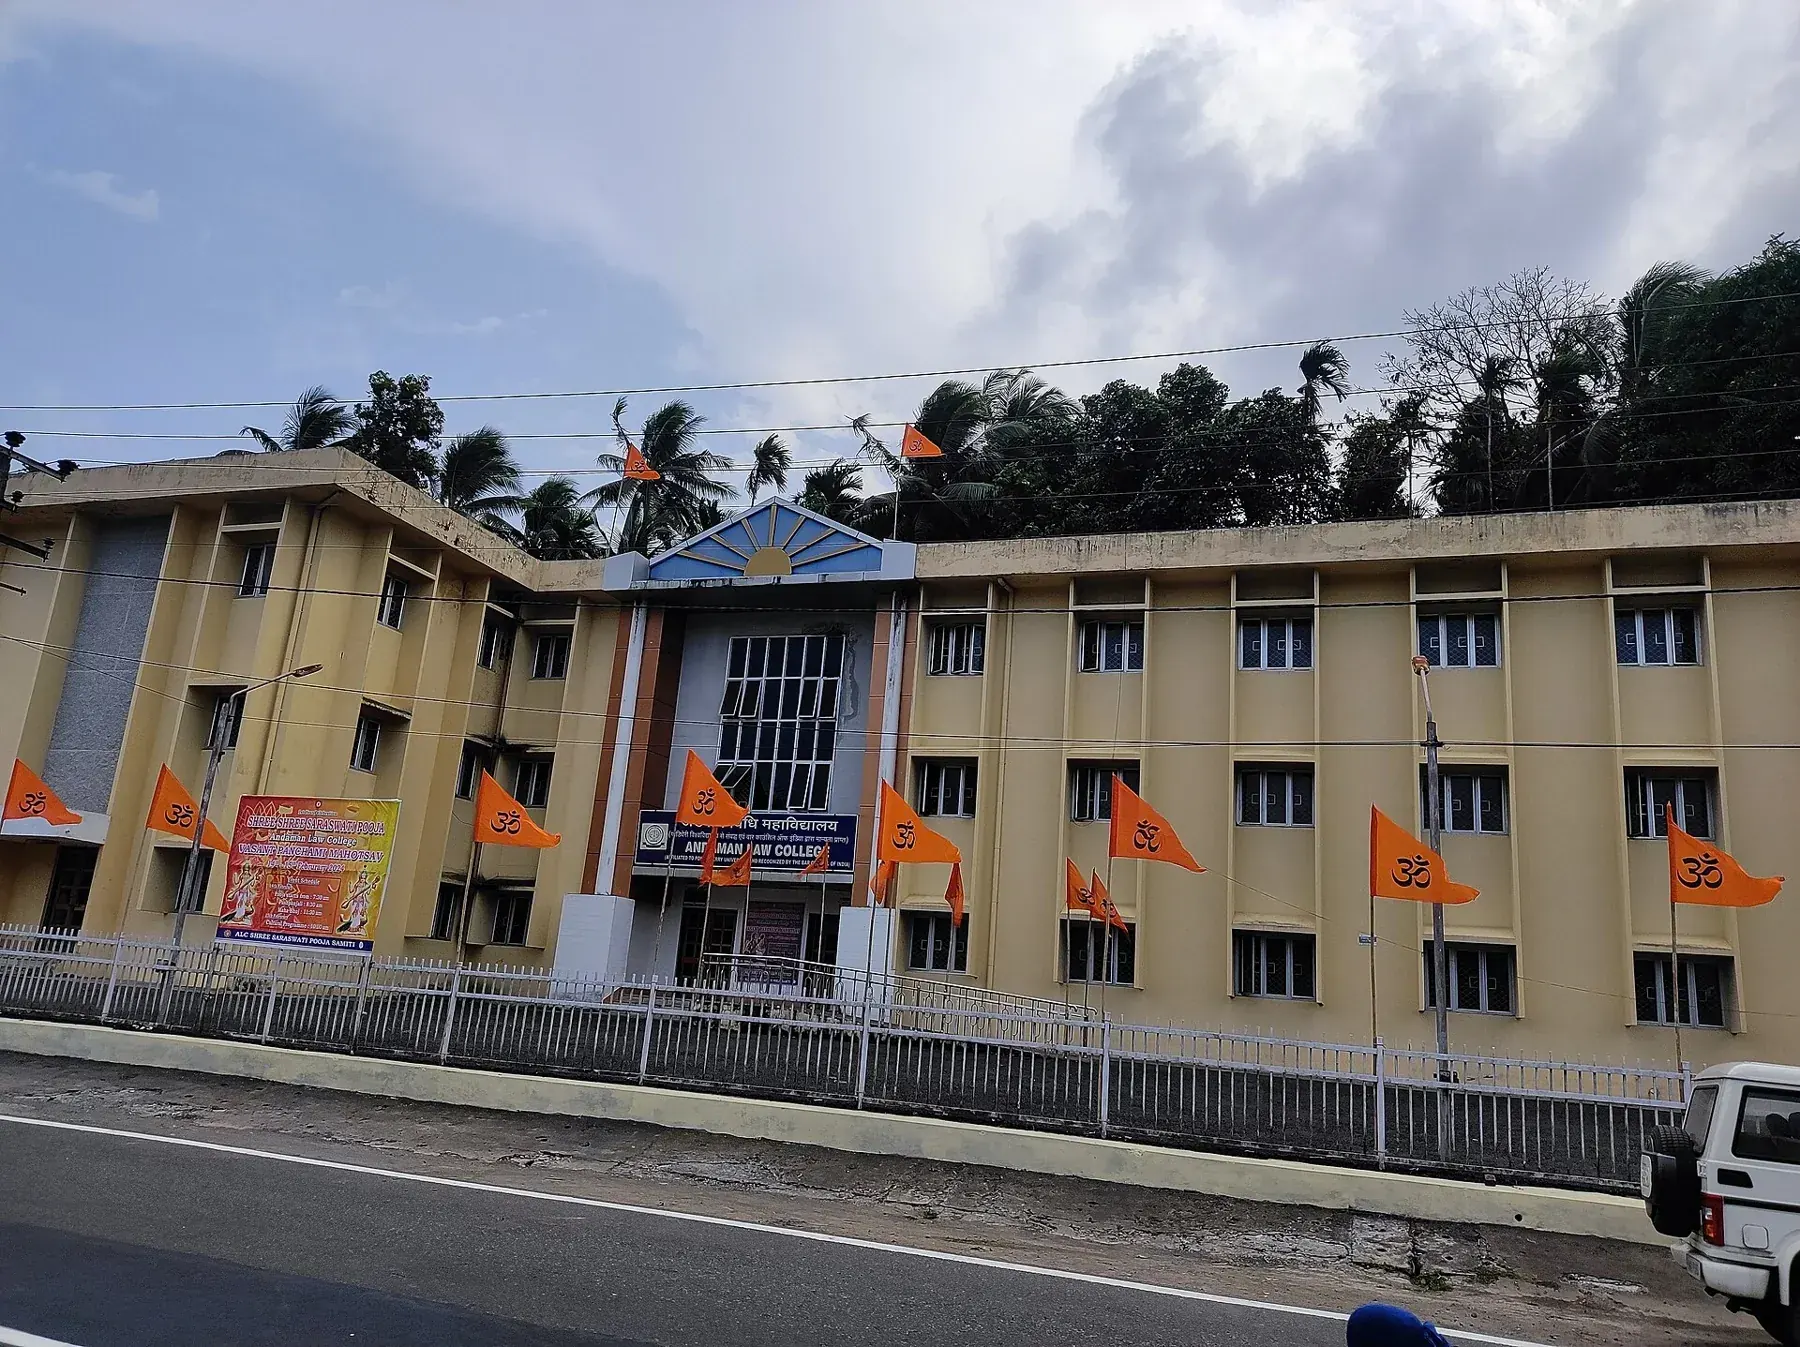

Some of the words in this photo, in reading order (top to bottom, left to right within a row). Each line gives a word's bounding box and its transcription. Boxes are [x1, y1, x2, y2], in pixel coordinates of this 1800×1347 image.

[247, 815, 276, 828] SHREE
[277, 816, 306, 830] SHREE
[306, 817, 356, 834] SARASWATI
[357, 820, 385, 835] POOJA
[762, 816, 839, 831] महाविद्यालय
[270, 833, 306, 842] Andaman
[308, 834, 325, 843] Law
[327, 836, 357, 847] College
[239, 843, 276, 855] VASANT
[277, 845, 327, 858] PANCHAMI
[328, 848, 384, 862] MAHOTSAV
[685, 841, 743, 855] ANMAN
[774, 844, 830, 859] COLLEG
[234, 930, 249, 938] ALC
[249, 932, 271, 940] SHREE
[272, 934, 308, 944] SARASWATI
[309, 937, 331, 946] POOJA
[331, 939, 356, 948] SAMITI
